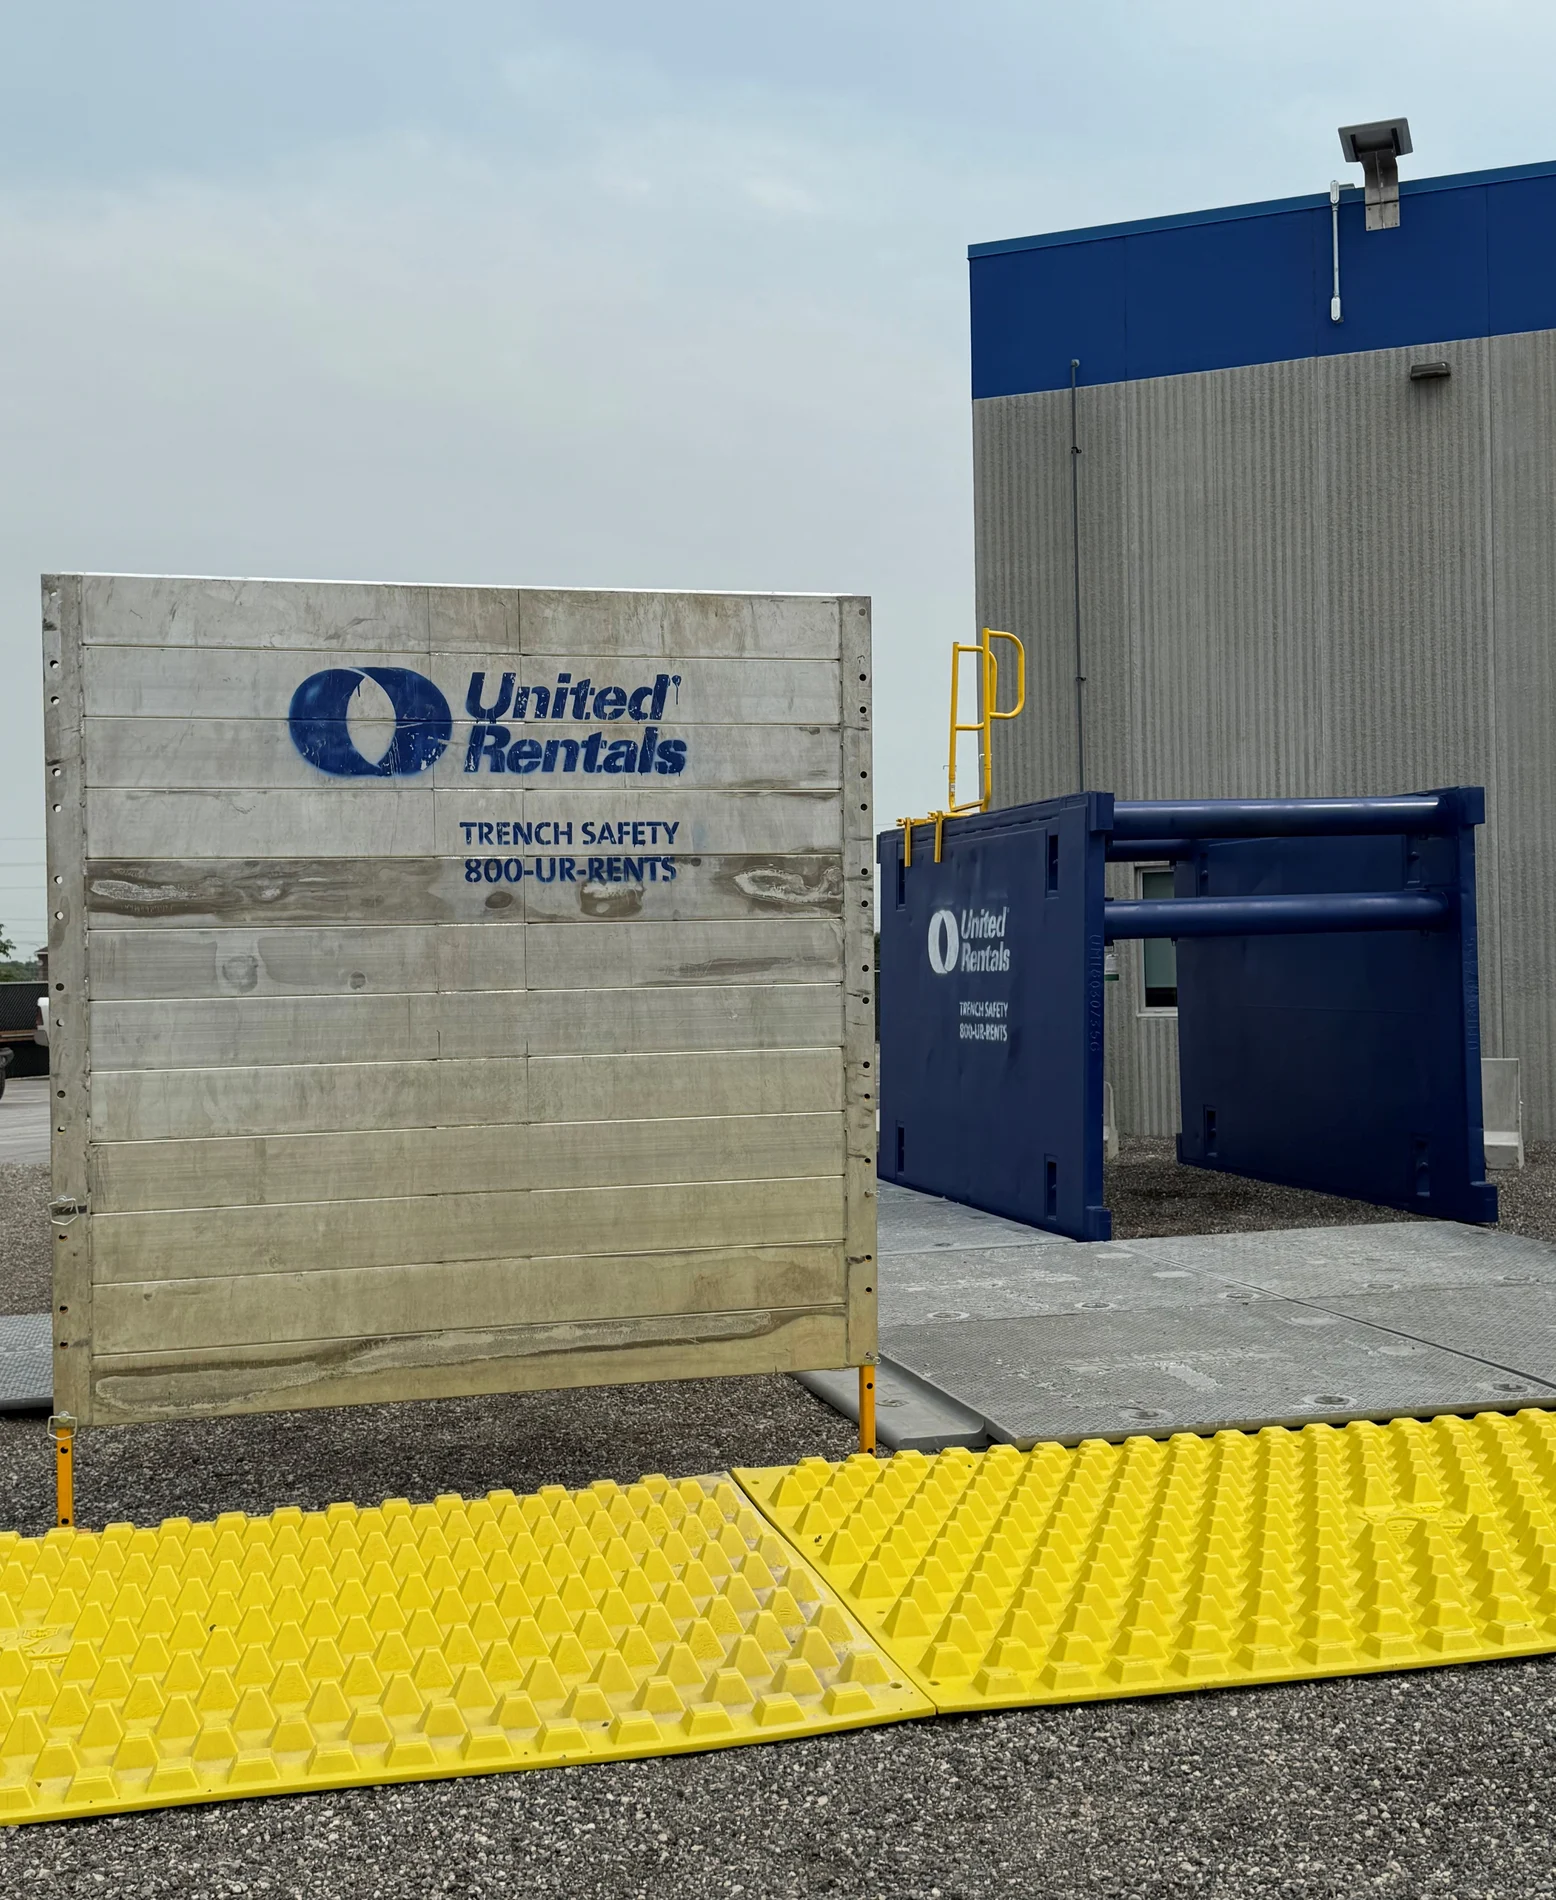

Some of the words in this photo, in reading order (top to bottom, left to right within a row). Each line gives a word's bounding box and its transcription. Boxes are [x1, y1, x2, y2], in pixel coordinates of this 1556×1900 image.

[465, 672, 670, 721] United
[464, 726, 687, 775] Rentals
[459, 821, 573, 846] TRENCH
[581, 821, 680, 846] SAFETY
[464, 857, 677, 883] 800-UR-RENTS
[961, 906, 1007, 939] United
[961, 941, 1010, 972] Rentals
[959, 1001, 984, 1017] TRENCH
[985, 1001, 1008, 1018] SAFETY
[960, 1022, 1008, 1042] 800-UR-RENTS
